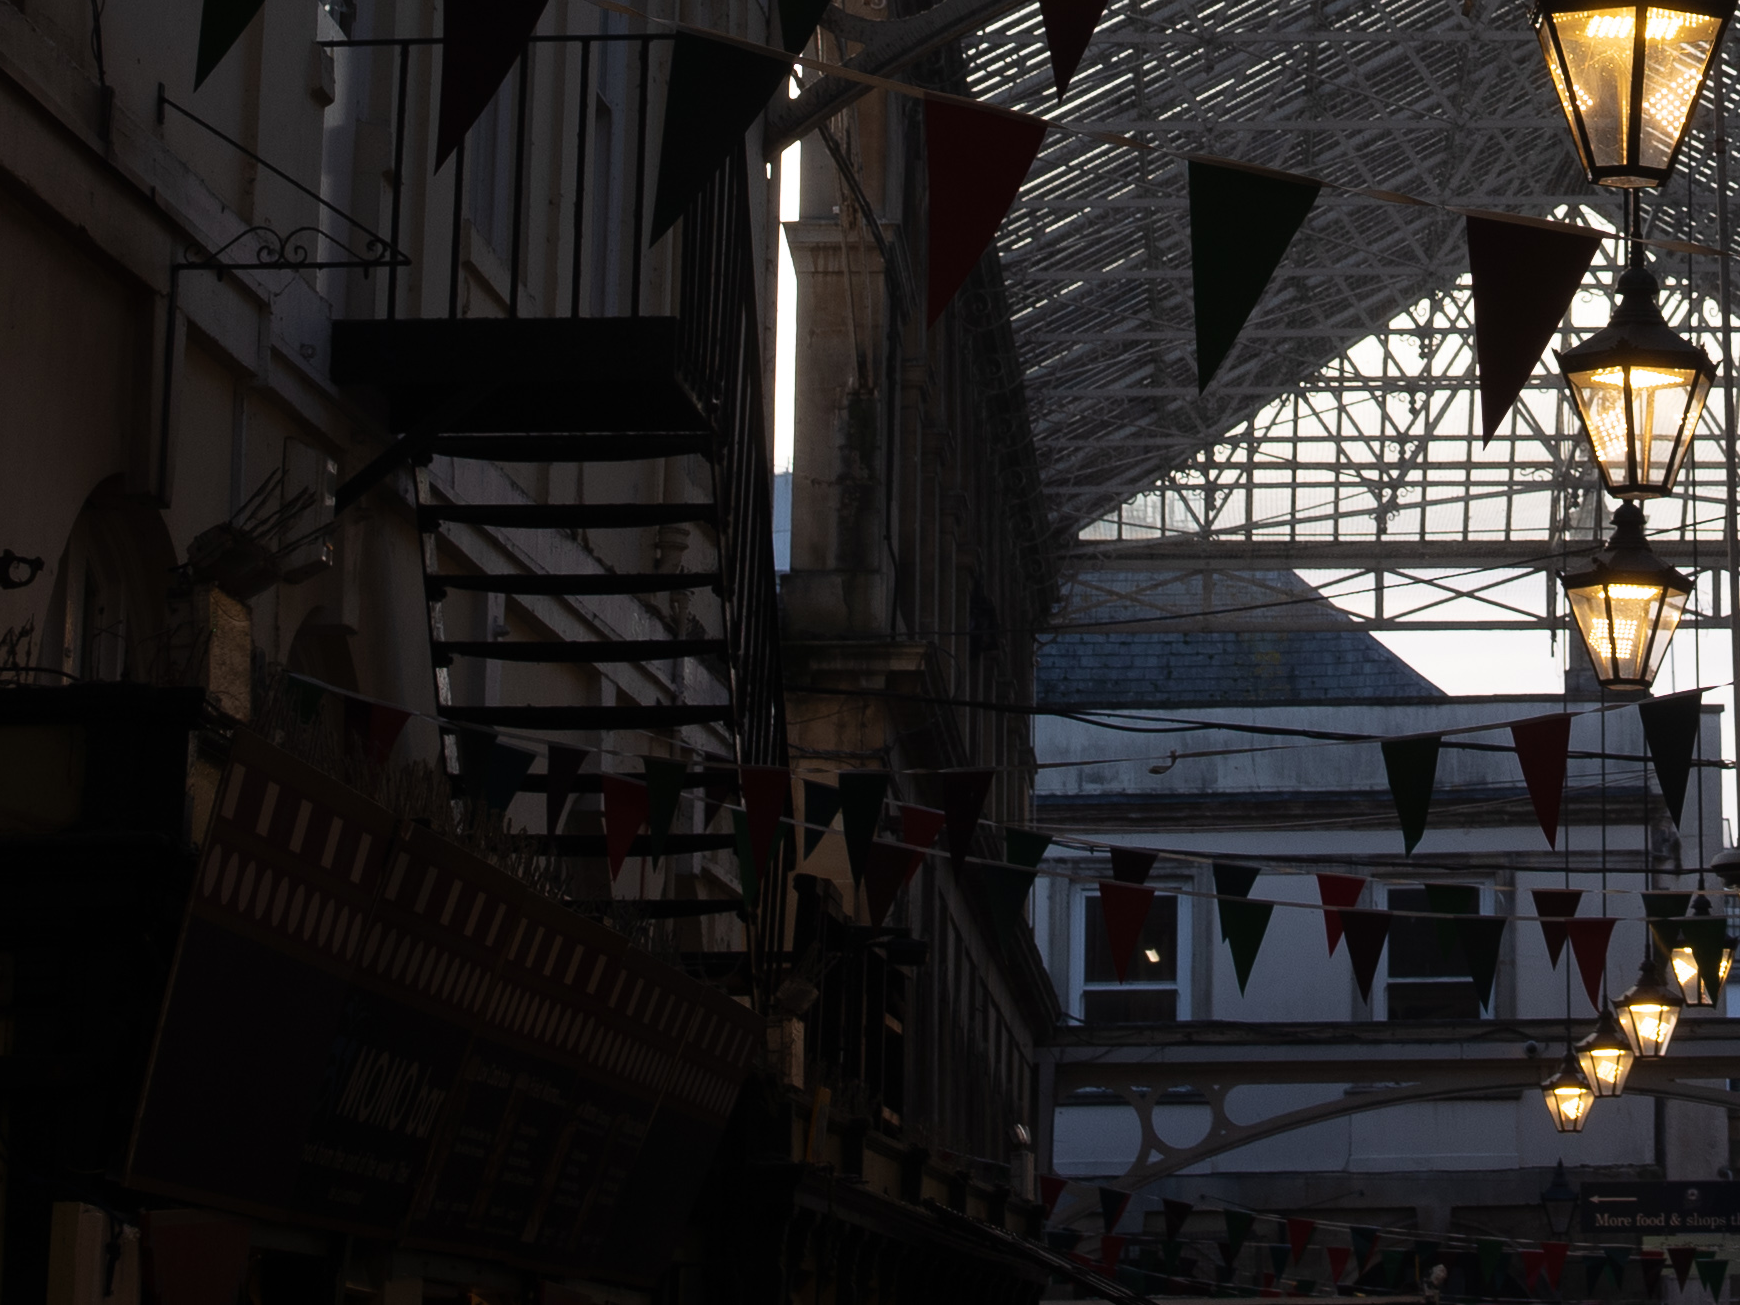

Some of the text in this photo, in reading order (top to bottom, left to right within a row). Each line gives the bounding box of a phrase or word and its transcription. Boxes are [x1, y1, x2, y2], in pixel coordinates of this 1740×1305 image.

[335, 1045, 420, 1133] MOMO
[404, 1065, 447, 1139] bar
[1595, 1213, 1633, 1228] More
[1636, 1212, 1666, 1227] food
[1669, 1212, 1682, 1227] &
[1686, 1212, 1727, 1230] shops
